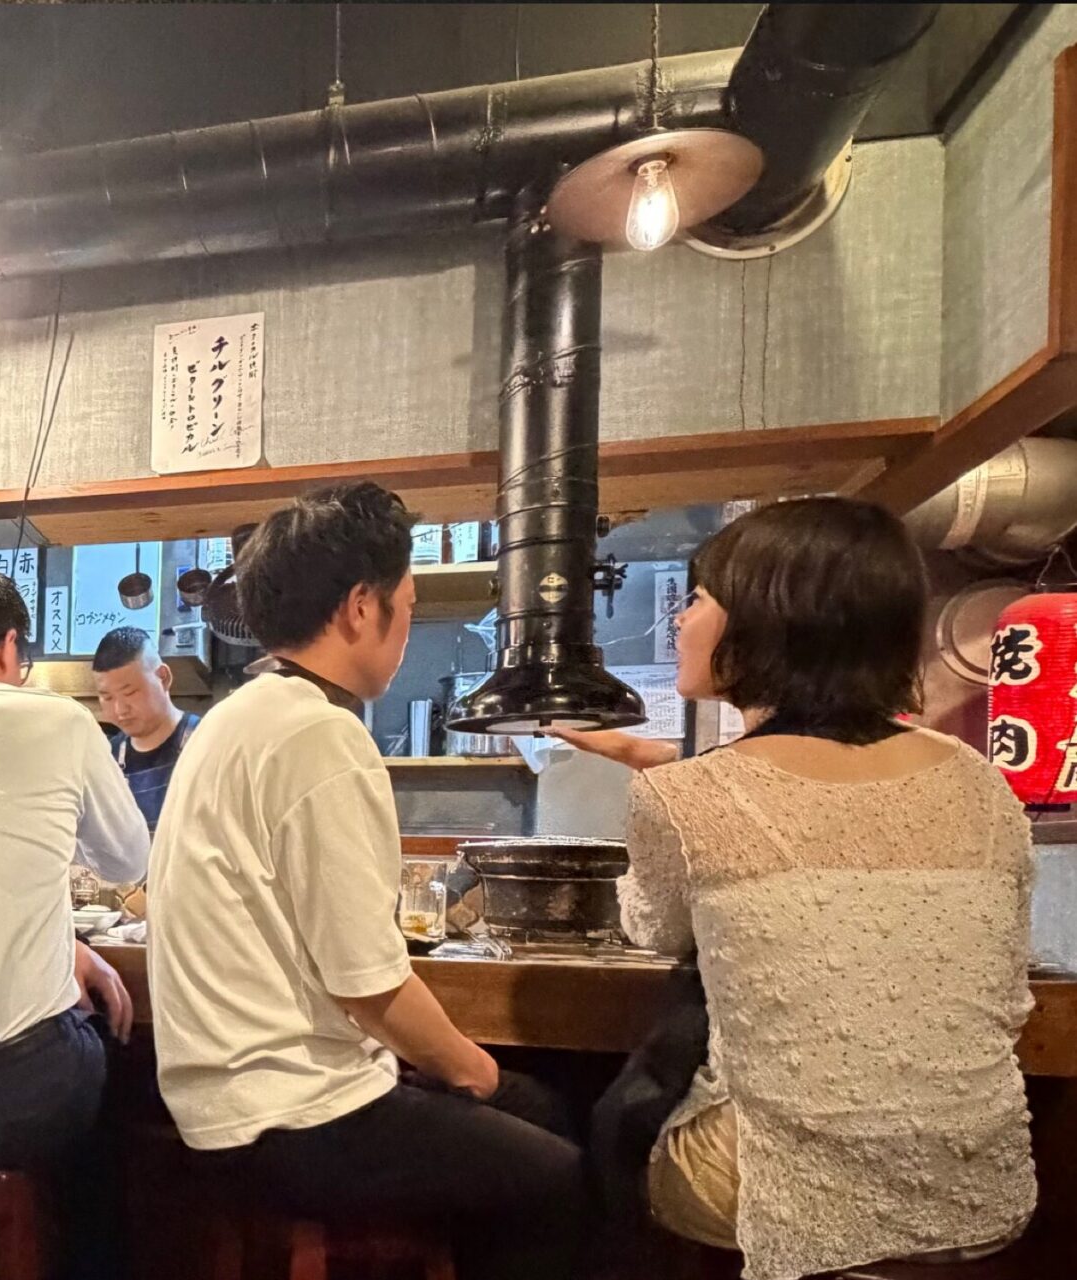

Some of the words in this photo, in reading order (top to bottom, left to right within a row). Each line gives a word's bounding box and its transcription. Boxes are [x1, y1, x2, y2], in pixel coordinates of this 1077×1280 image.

[210, 335, 230, 437] チルグリーン
[18, 552, 34, 574] 赤
[51, 590, 64, 651] オススメ
[989, 627, 1034, 767] 焼肉
